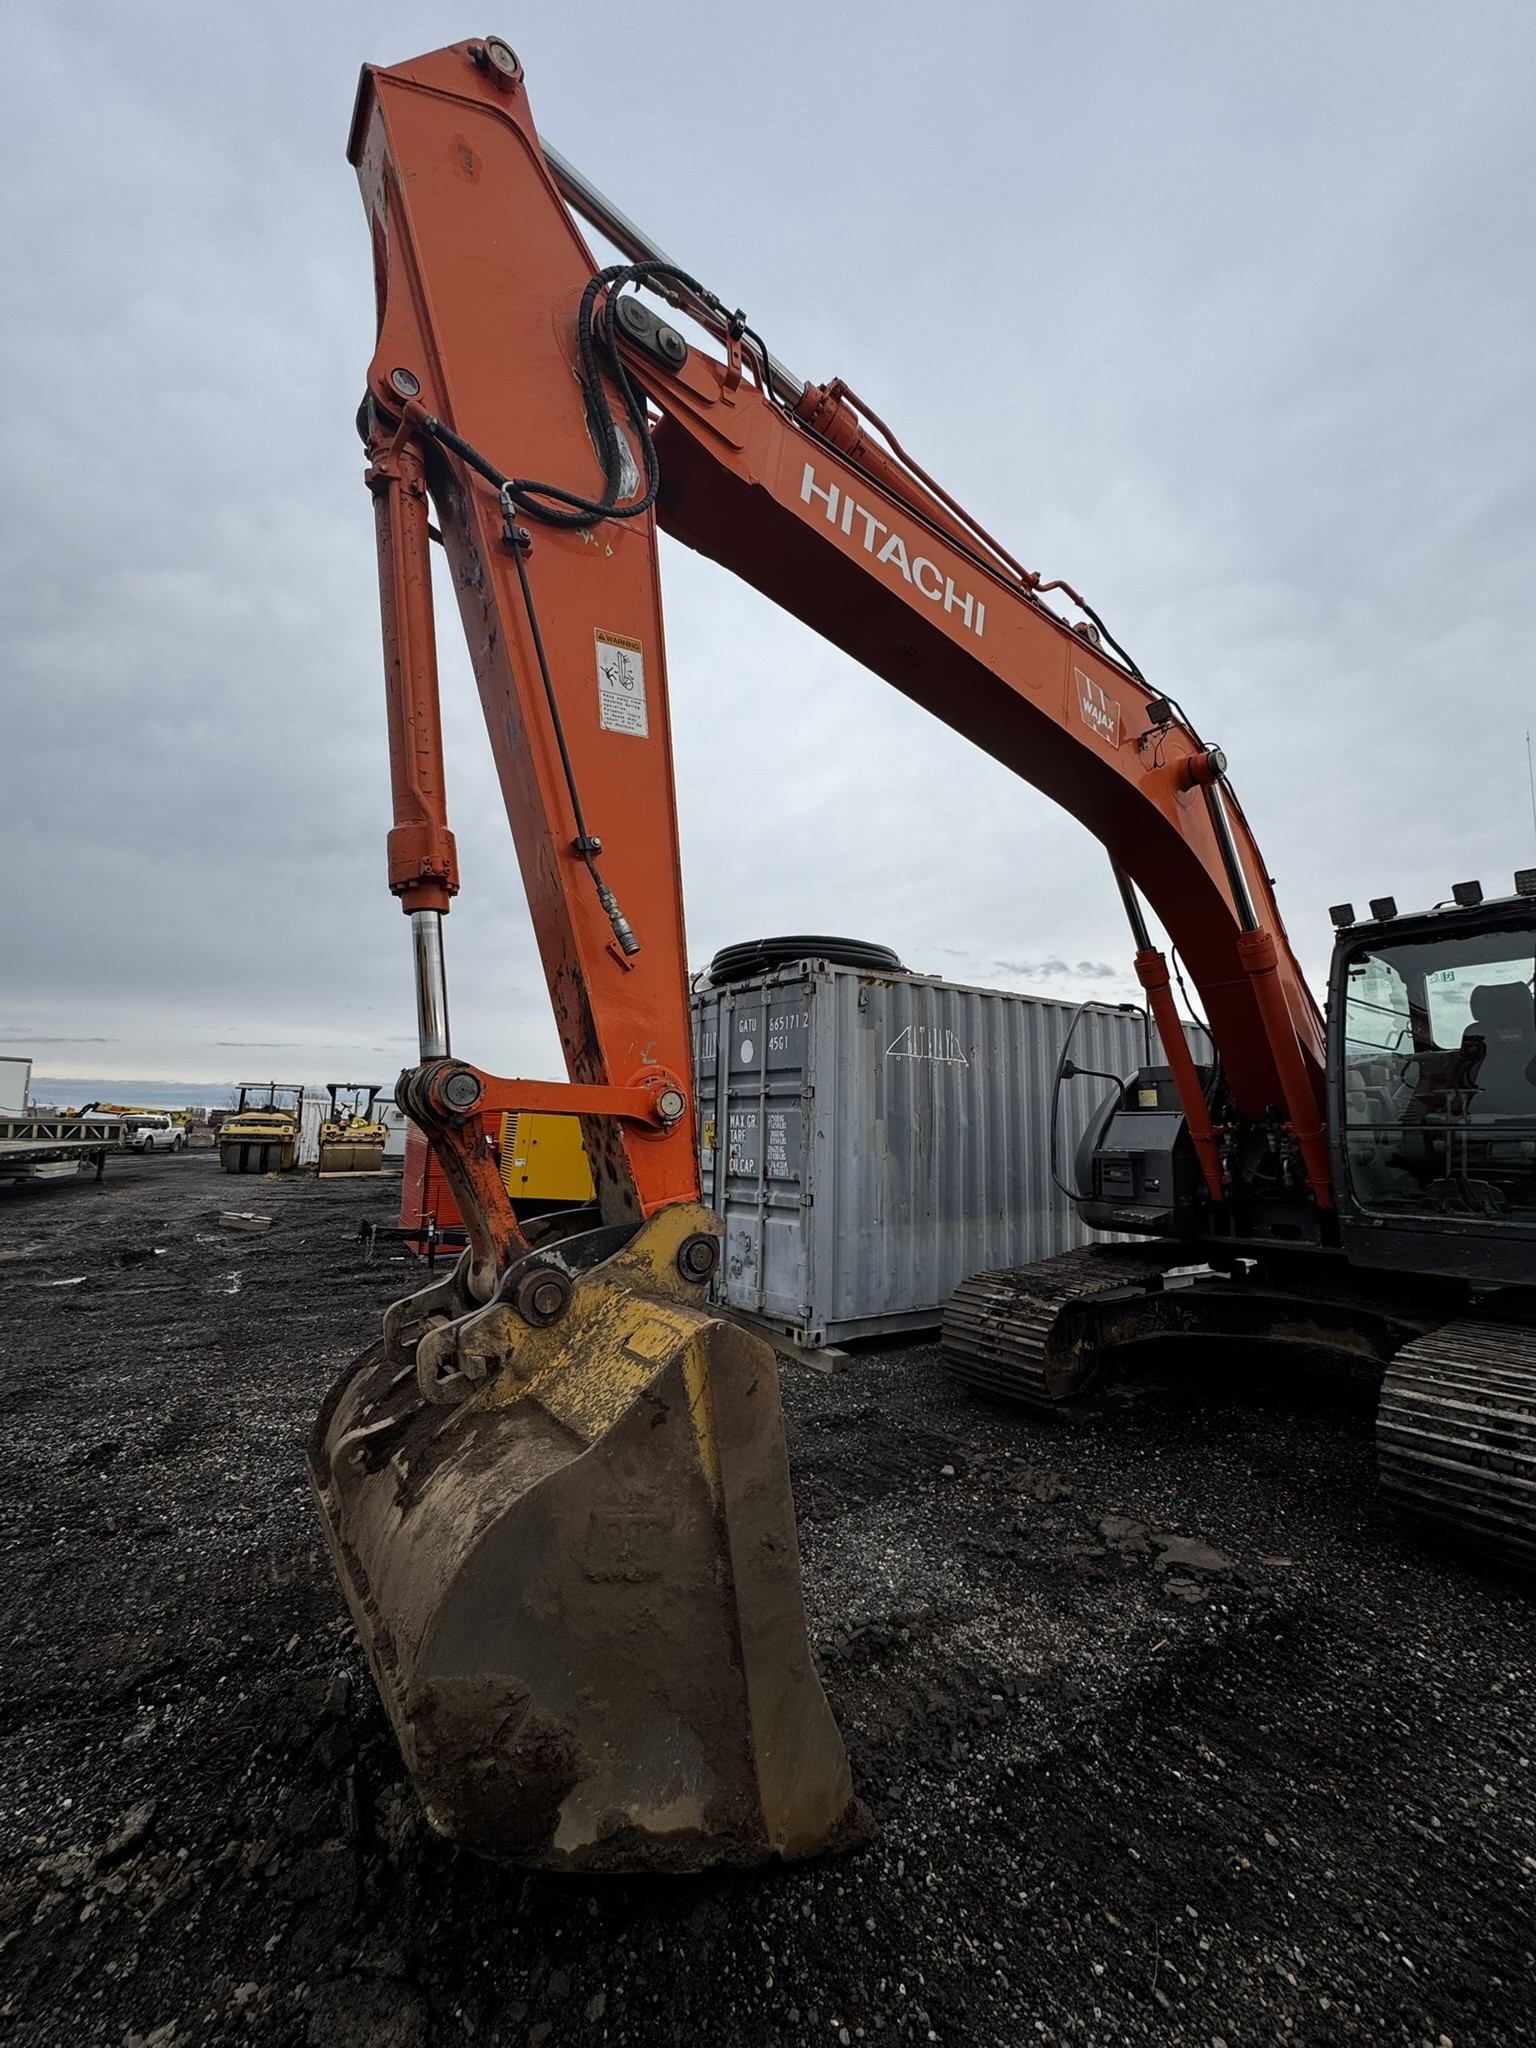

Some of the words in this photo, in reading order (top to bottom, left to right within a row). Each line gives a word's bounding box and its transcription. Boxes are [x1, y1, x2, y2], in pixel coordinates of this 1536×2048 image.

[800, 462, 985, 637] HITACHI
[606, 635, 640, 650] WARNING
[1083, 697, 1114, 732] WAJAX
[739, 1018, 757, 1032] GATU
[769, 1014, 799, 1031] 865171
[803, 1012, 809, 1028] 2
[769, 1036, 788, 1050] 45G1
[730, 1130, 746, 1143] TARE
